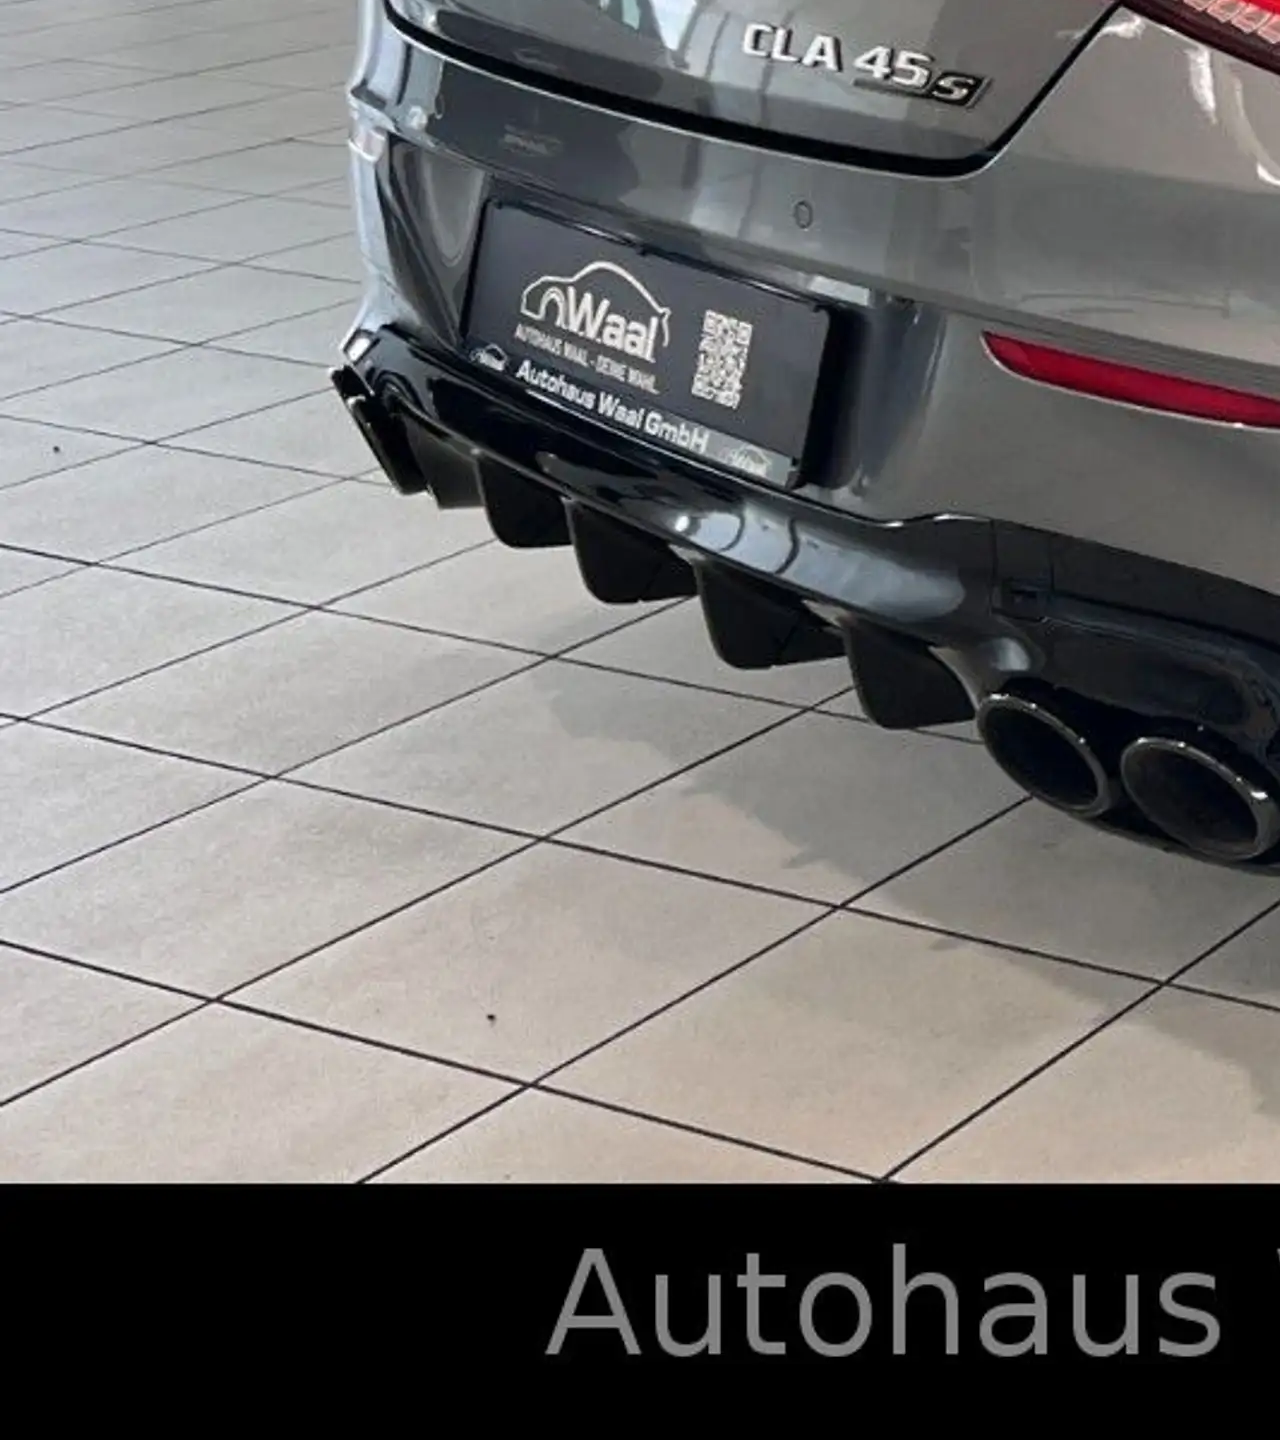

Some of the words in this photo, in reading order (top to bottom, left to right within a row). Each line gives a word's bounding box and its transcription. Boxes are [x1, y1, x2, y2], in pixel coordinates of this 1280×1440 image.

[743, 23, 844, 72] CLA
[566, 285, 658, 363] Waal
[515, 359, 597, 410] Autohaus
[597, 390, 646, 429] Waal
[643, 411, 710, 454] GmbH
